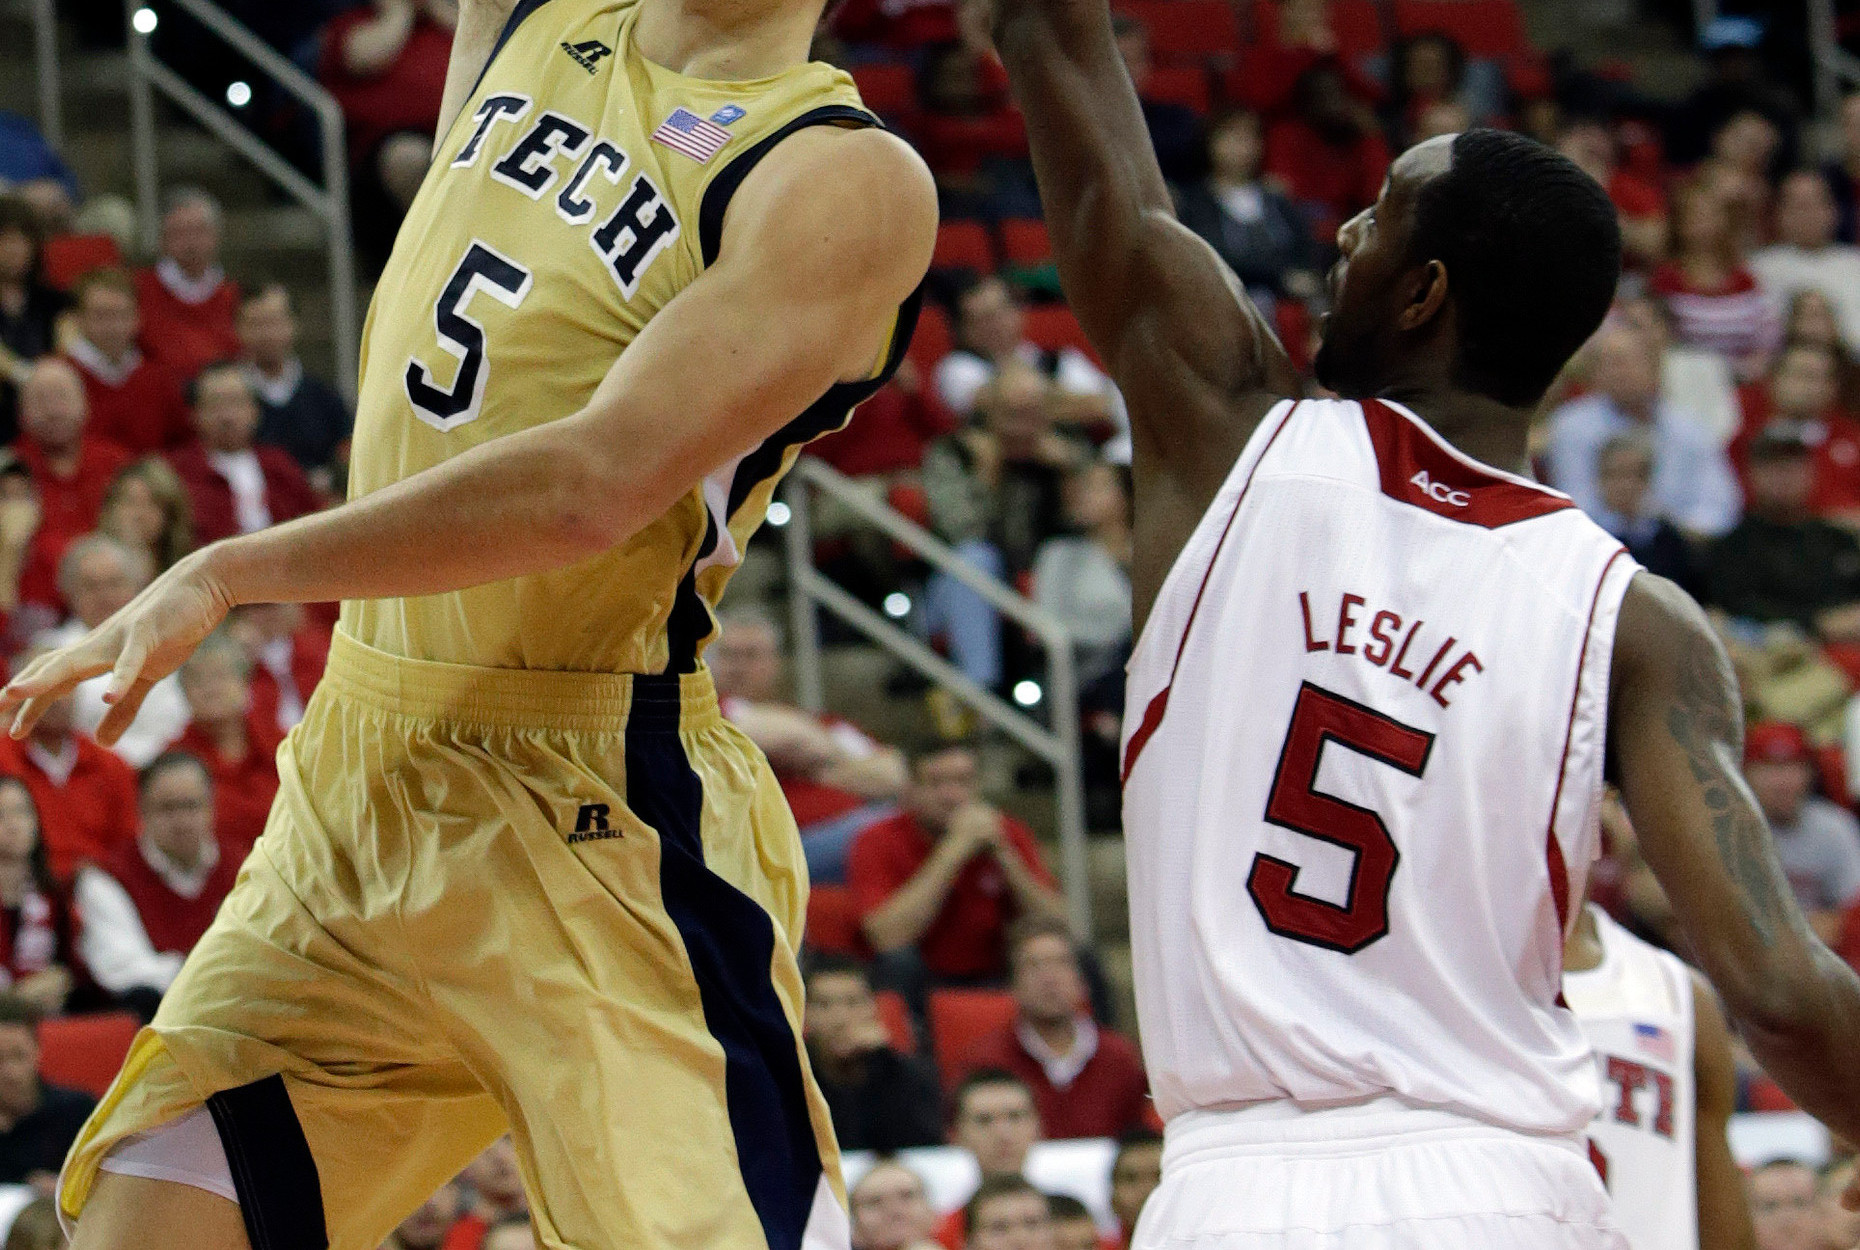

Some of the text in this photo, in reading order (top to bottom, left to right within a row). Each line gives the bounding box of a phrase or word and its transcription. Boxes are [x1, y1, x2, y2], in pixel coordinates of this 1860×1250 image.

[450, 91, 681, 302] TECH
[404, 238, 534, 433] 5
[1409, 469, 1472, 507] ACC
[1298, 590, 1485, 709] LESLIE
[568, 829, 625, 844] RUSSELL
[1245, 678, 1436, 956] 5
